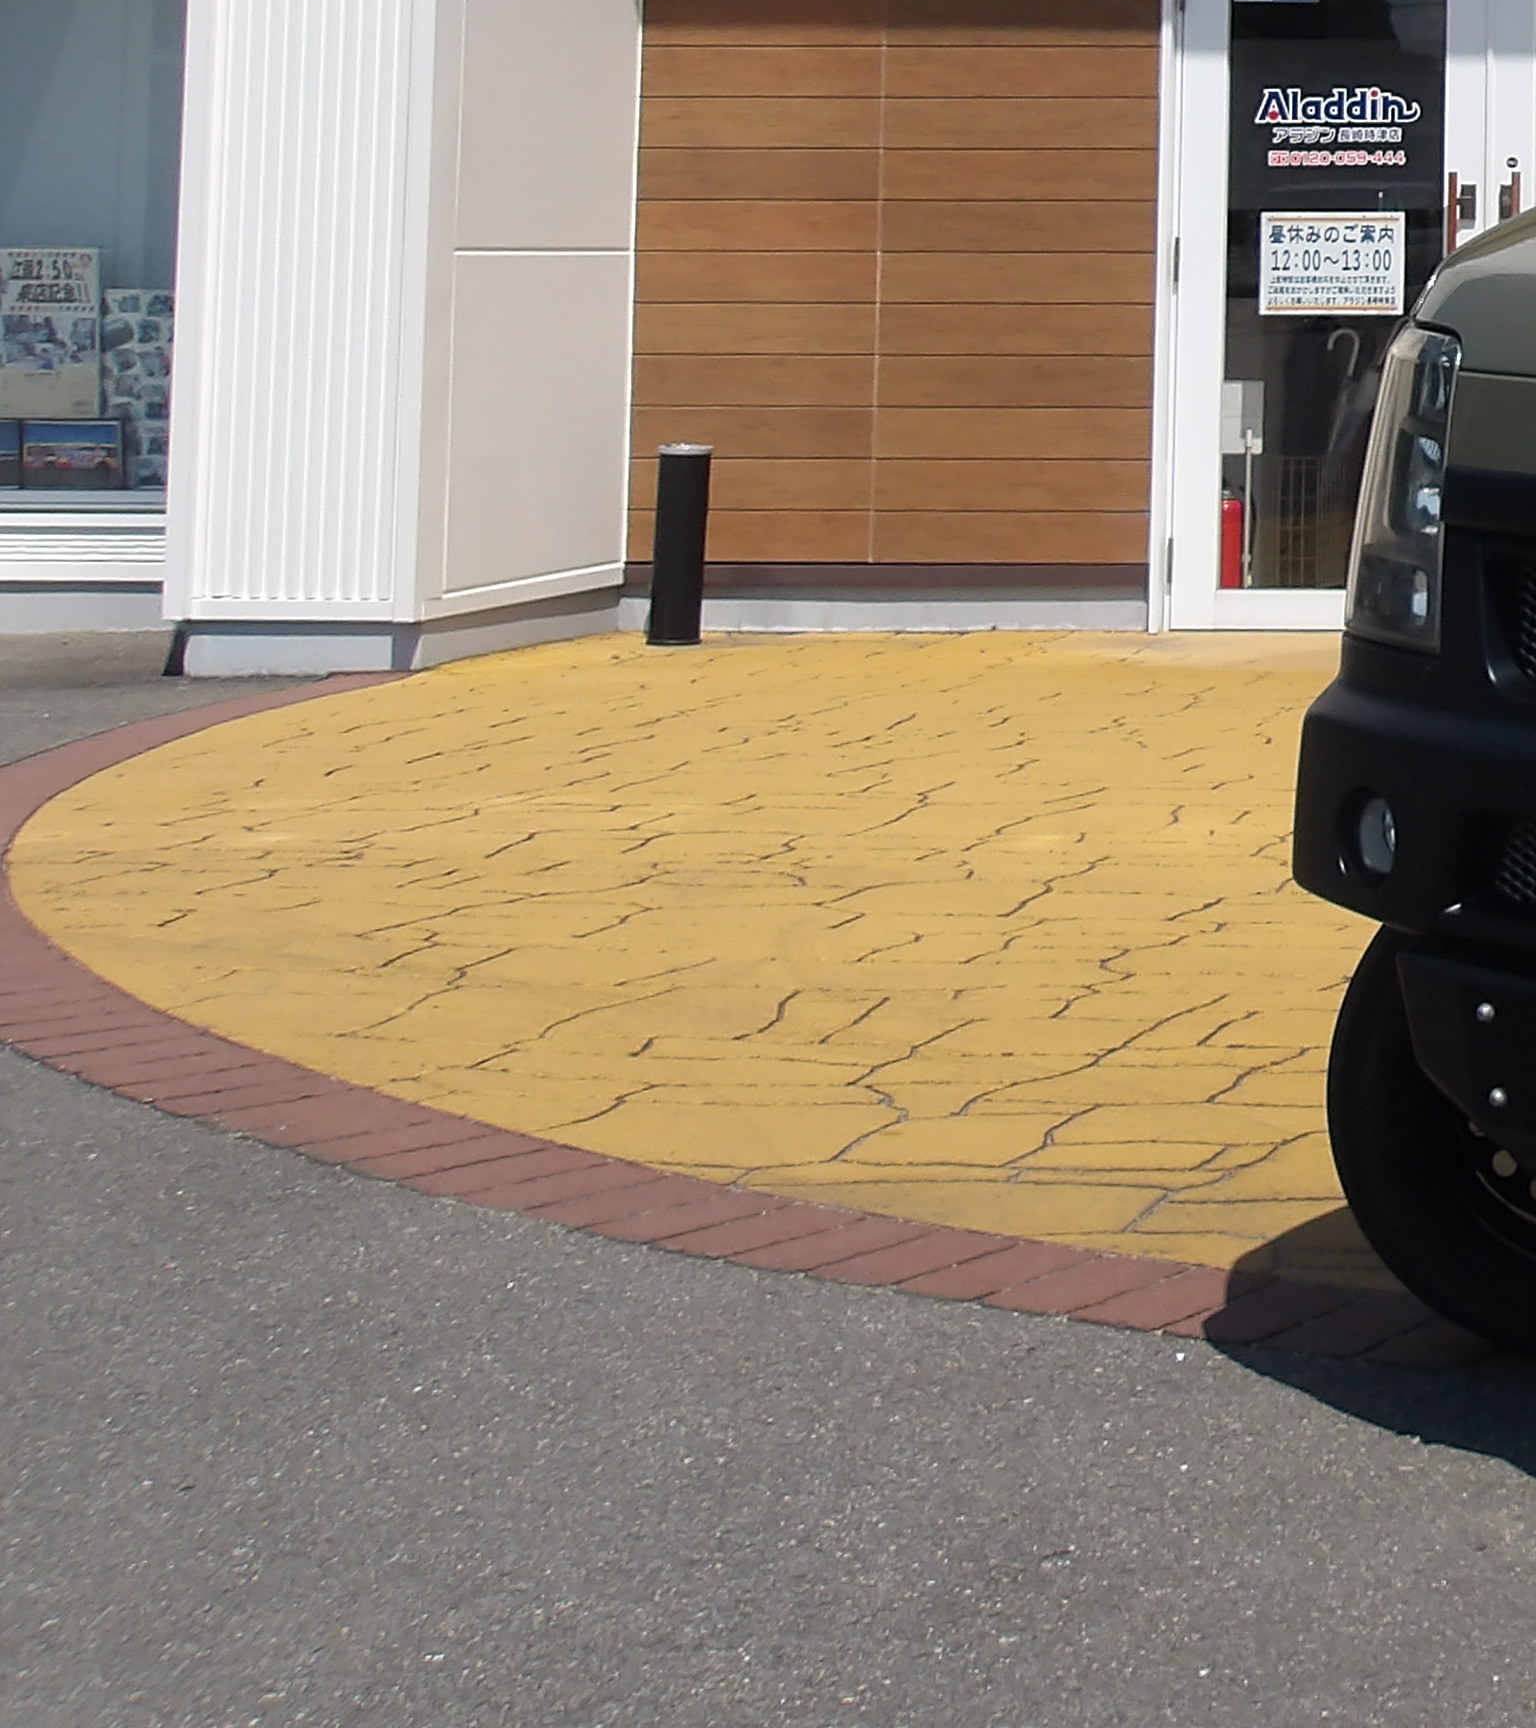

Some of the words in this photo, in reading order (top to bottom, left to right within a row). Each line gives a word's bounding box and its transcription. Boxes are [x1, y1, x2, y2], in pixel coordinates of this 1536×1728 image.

[1255, 87, 1421, 123] Aladdin
[1272, 126, 1335, 143] アラジン
[1338, 127, 1402, 143] 長崎時津店
[1290, 151, 1406, 166] 0120-059-444
[1268, 224, 1395, 244] 昼休みのご案内
